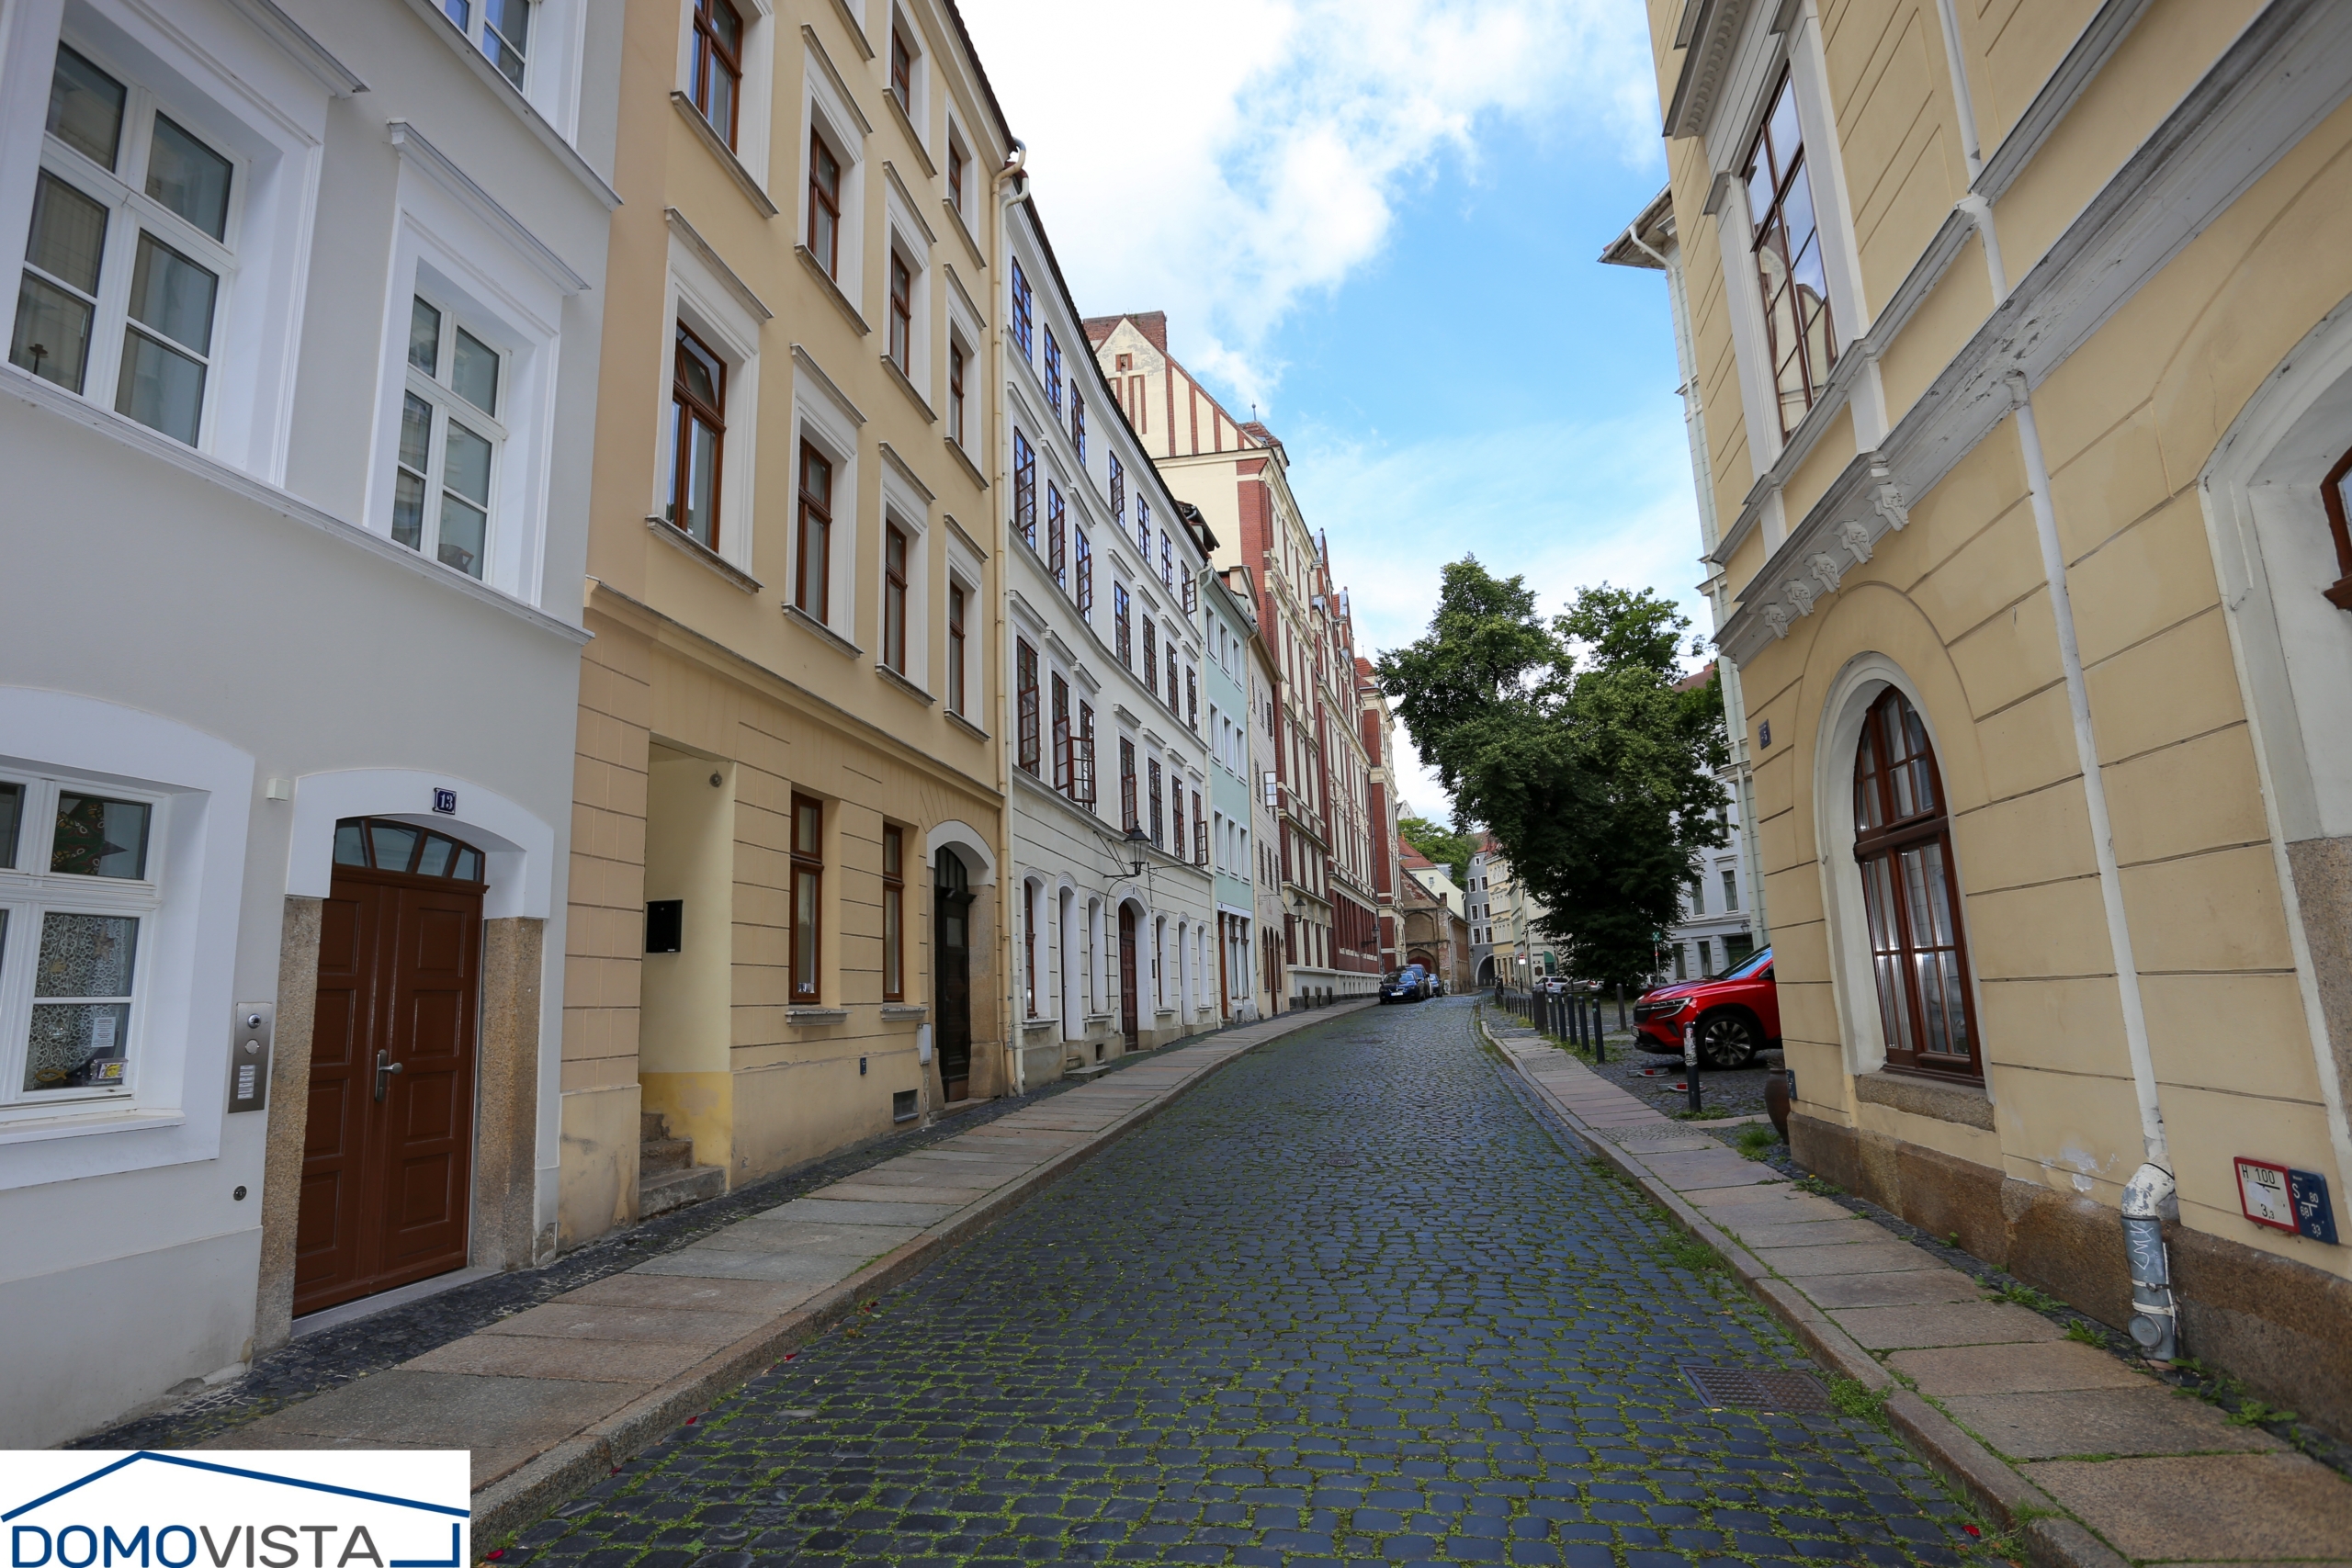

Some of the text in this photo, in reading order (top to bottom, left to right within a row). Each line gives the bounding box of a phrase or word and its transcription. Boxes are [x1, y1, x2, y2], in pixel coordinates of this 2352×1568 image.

[440, 794, 453, 810] 13
[2242, 1165, 2276, 1184] H 100
[2291, 1182, 2301, 1199] S
[2309, 1191, 2319, 1203] 80
